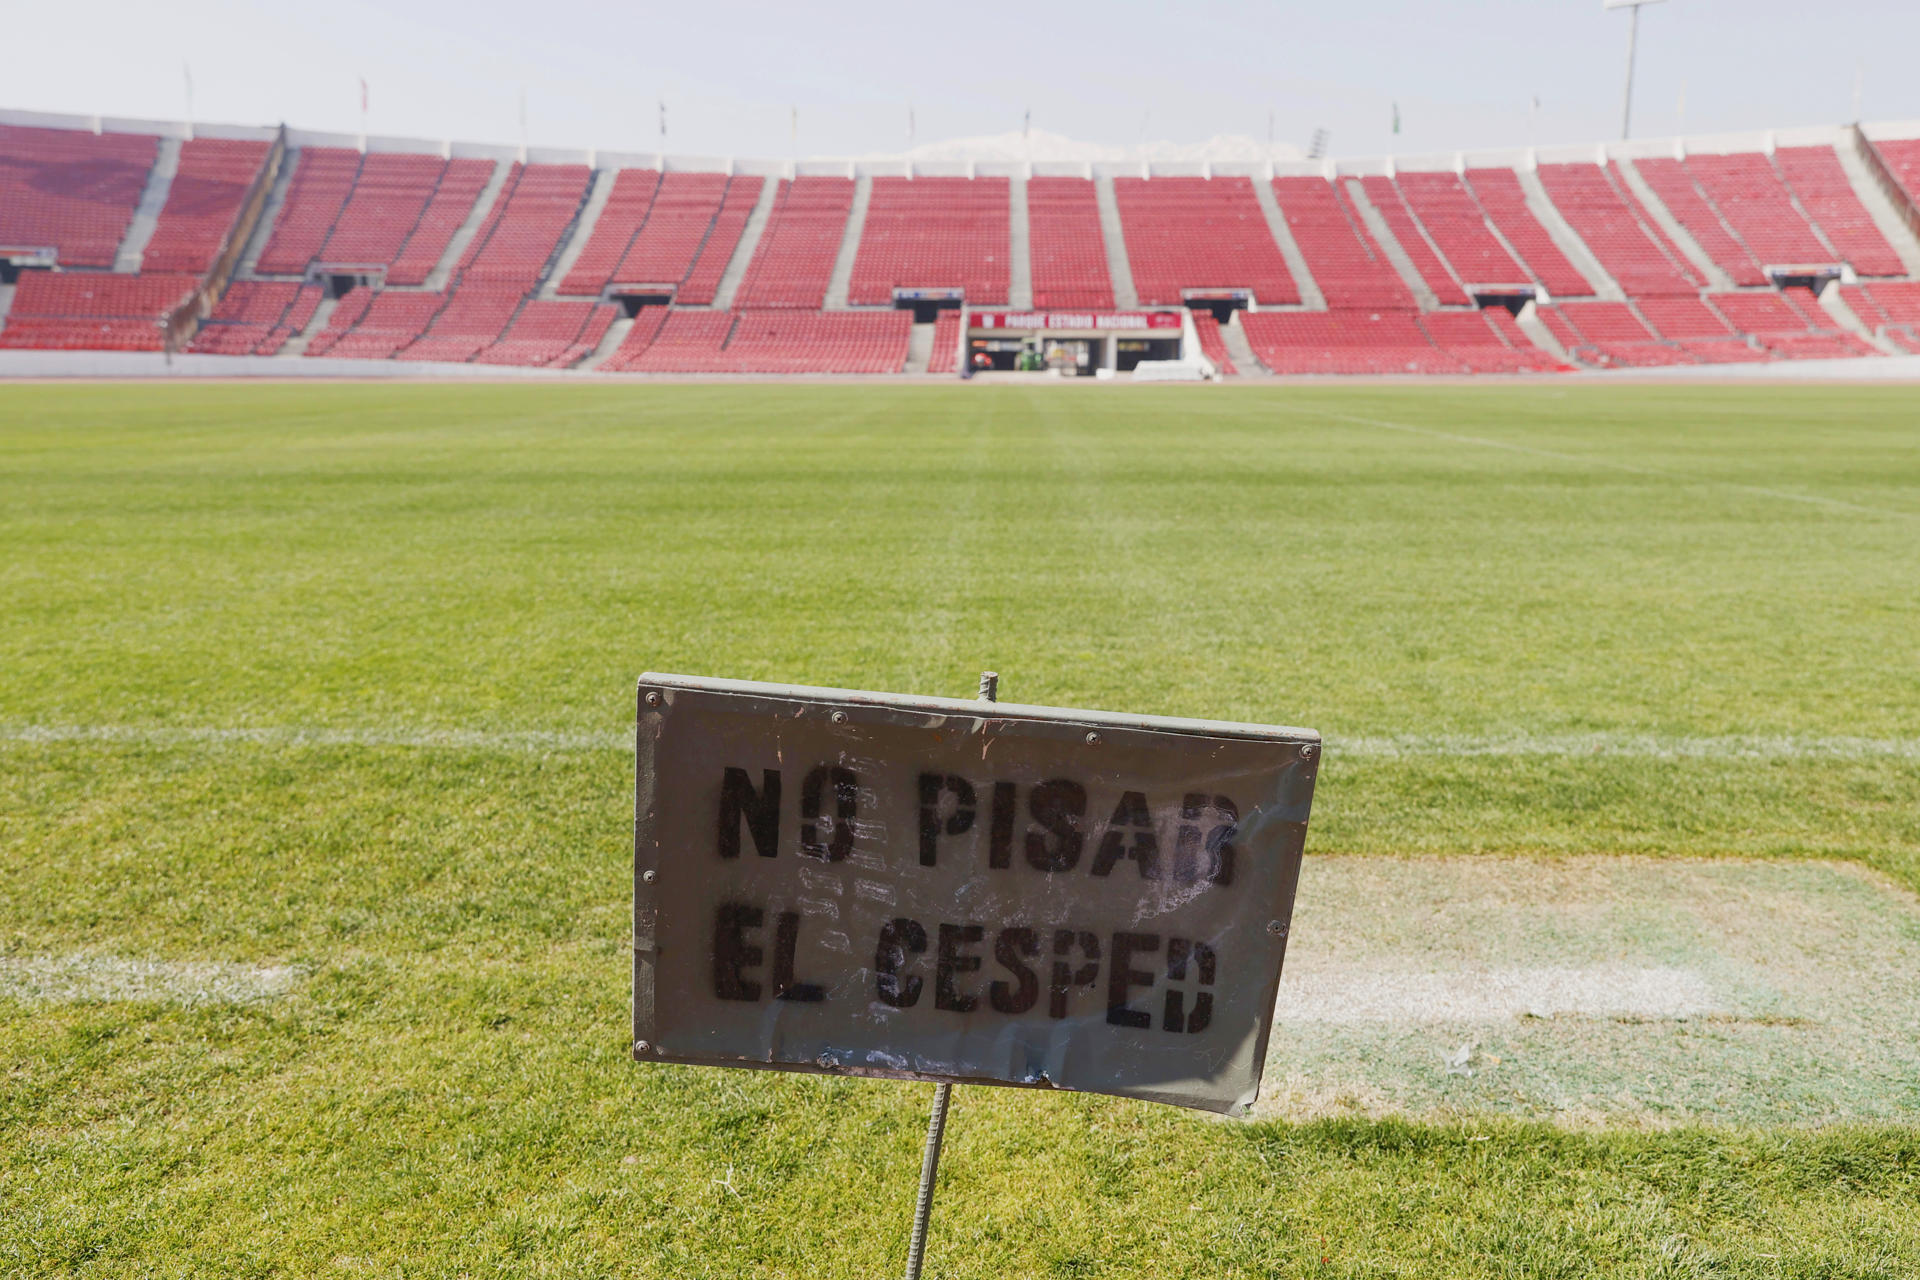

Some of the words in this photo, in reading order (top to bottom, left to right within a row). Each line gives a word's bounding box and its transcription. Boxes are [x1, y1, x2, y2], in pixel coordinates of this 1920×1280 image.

[718, 766, 857, 862] NO
[918, 772, 1240, 886] PISAR
[713, 903, 825, 1001] EL
[876, 917, 1216, 1034] CESPED
